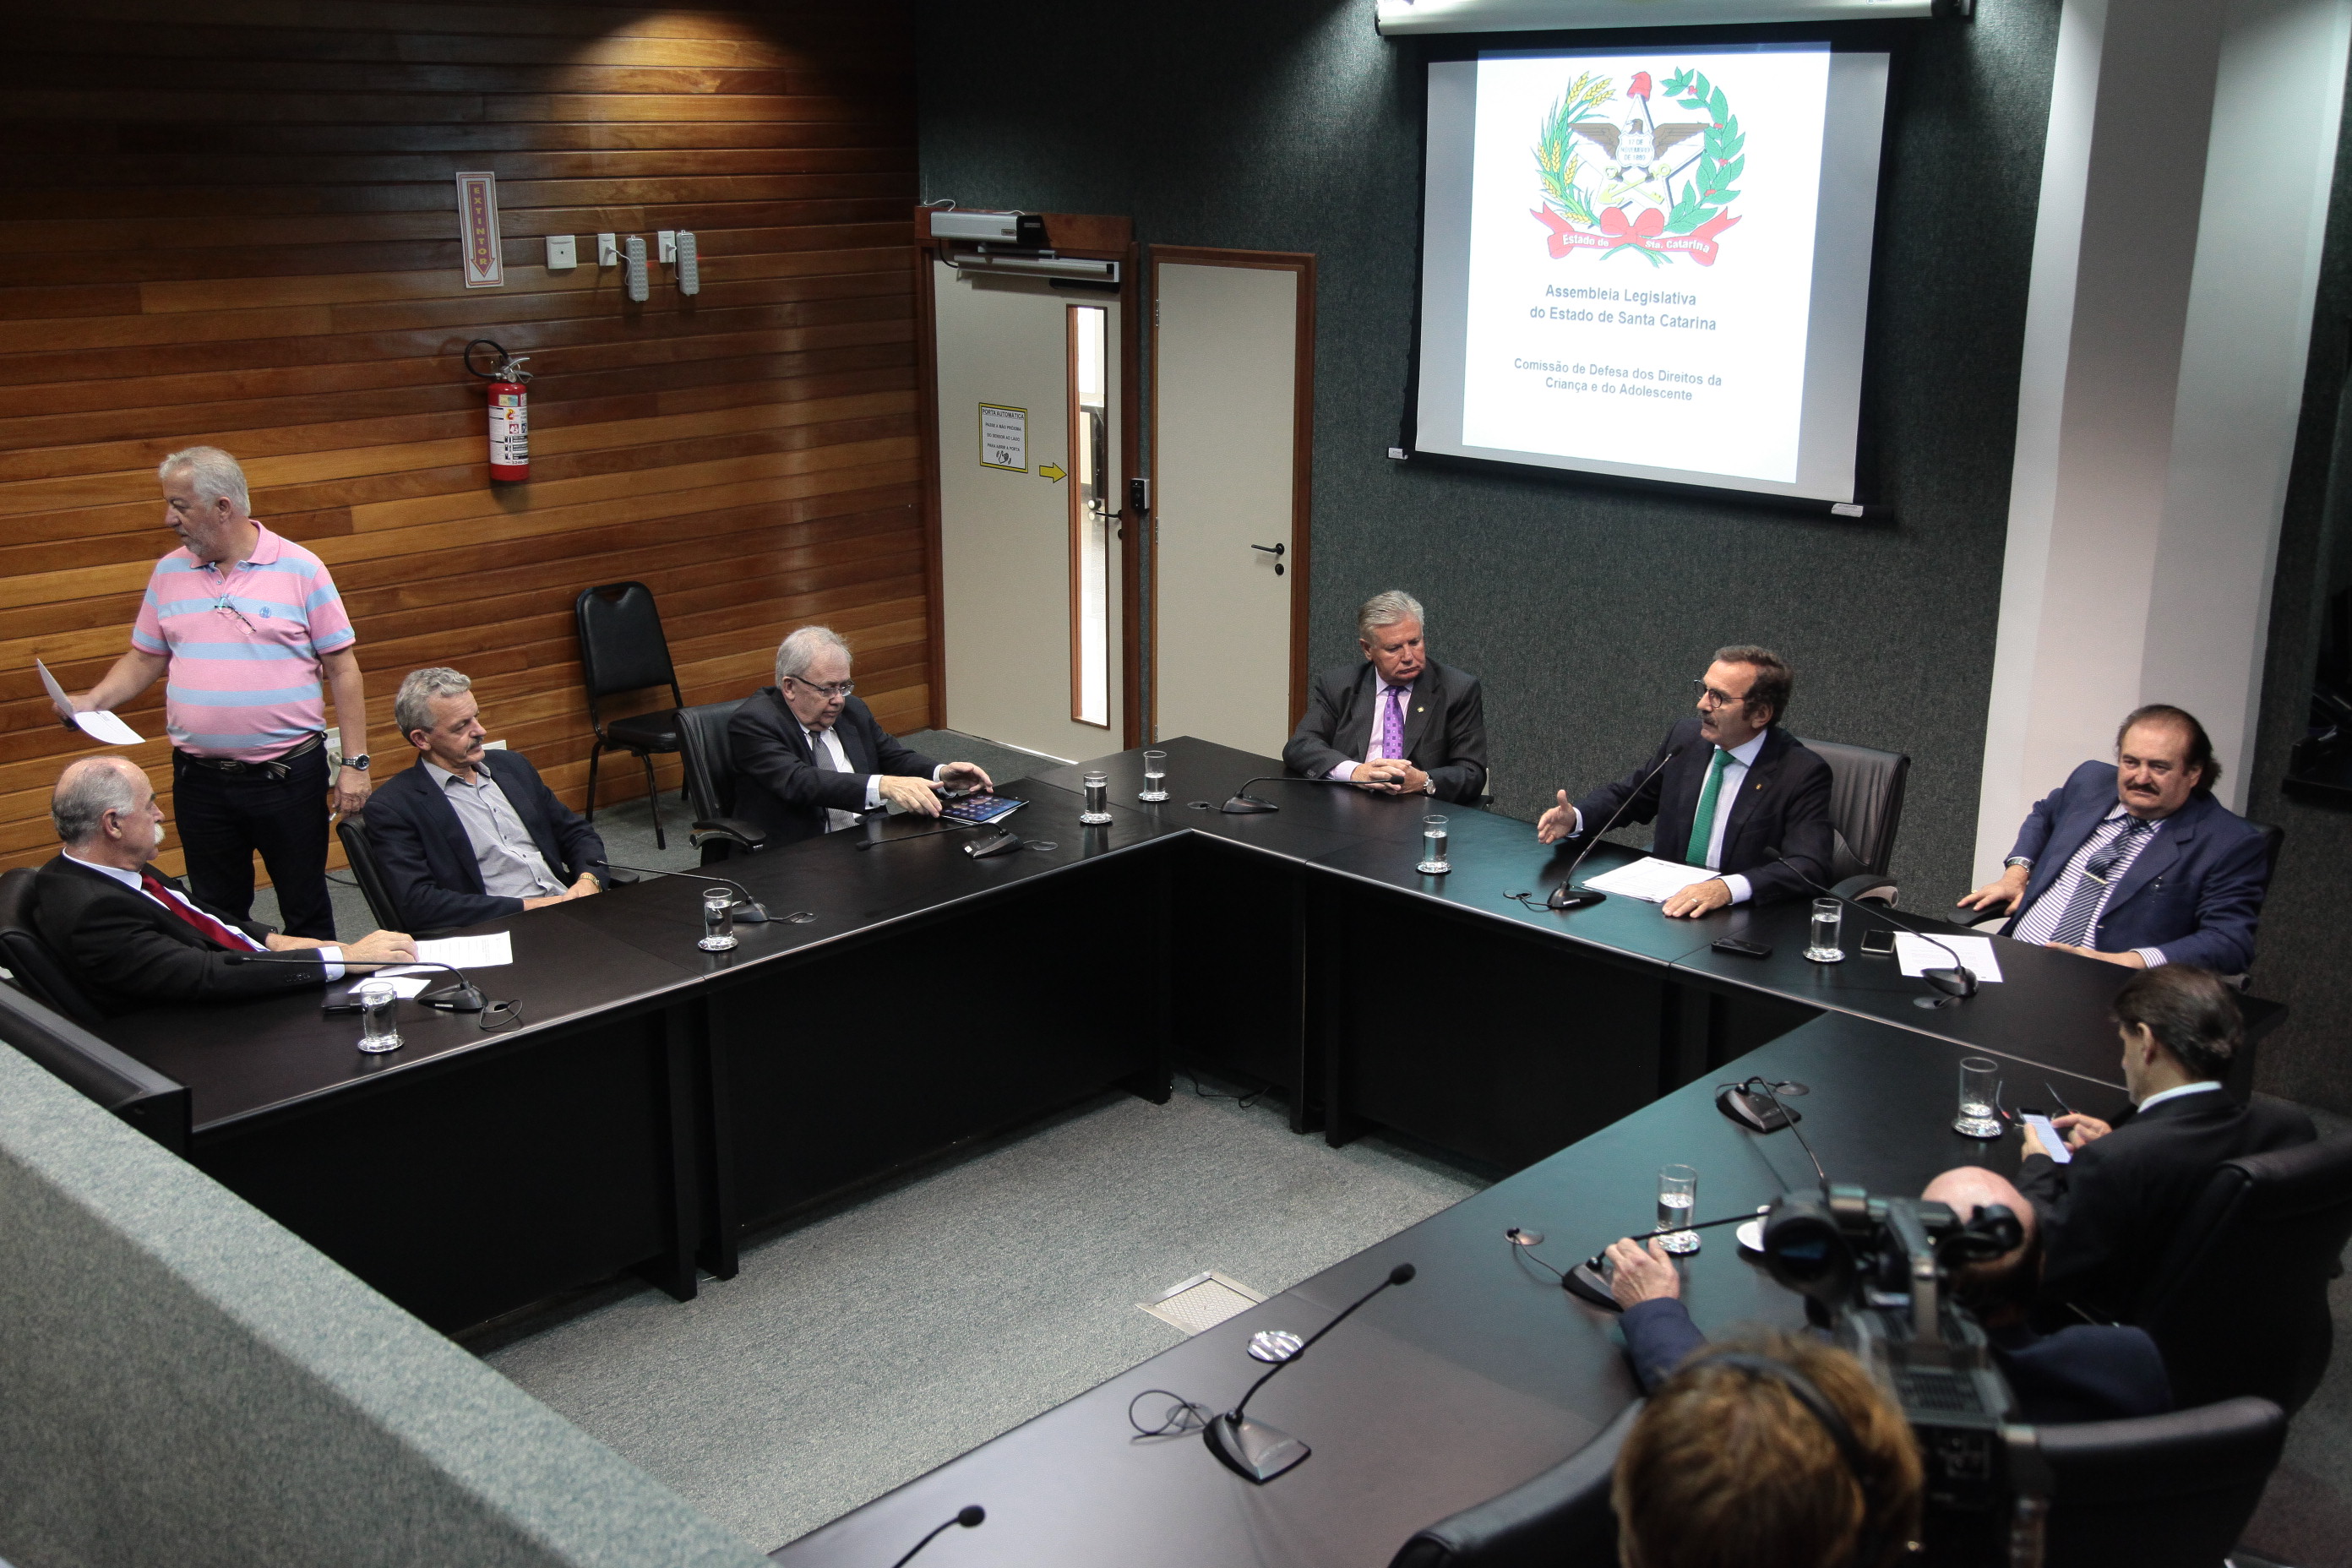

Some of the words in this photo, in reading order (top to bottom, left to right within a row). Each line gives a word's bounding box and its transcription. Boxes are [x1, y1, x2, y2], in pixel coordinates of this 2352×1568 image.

[473, 187, 487, 265] EXTINTOR
[1562, 234, 1594, 246] Estado
[1645, 240, 1663, 248] Sta.
[1666, 239, 1710, 253] Catarina
[1545, 284, 1620, 301] Assembleia
[1624, 289, 1696, 306] Legislativa
[1530, 306, 1545, 318] do
[1549, 307, 1593, 322] Estado
[1598, 310, 1614, 323] de
[1618, 311, 1655, 326] Santa
[1660, 313, 1717, 330] Catarina
[1514, 357, 1569, 373] Comissão
[1572, 362, 1586, 374] de
[1589, 363, 1629, 378] Defesa
[1632, 368, 1654, 380] dos
[1658, 369, 1703, 385] Direitos
[1707, 374, 1722, 386] da
[1545, 377, 1587, 393] Criança
[1591, 383, 1598, 391] e
[1602, 382, 1616, 394] do
[1620, 383, 1693, 400] Adolescente
